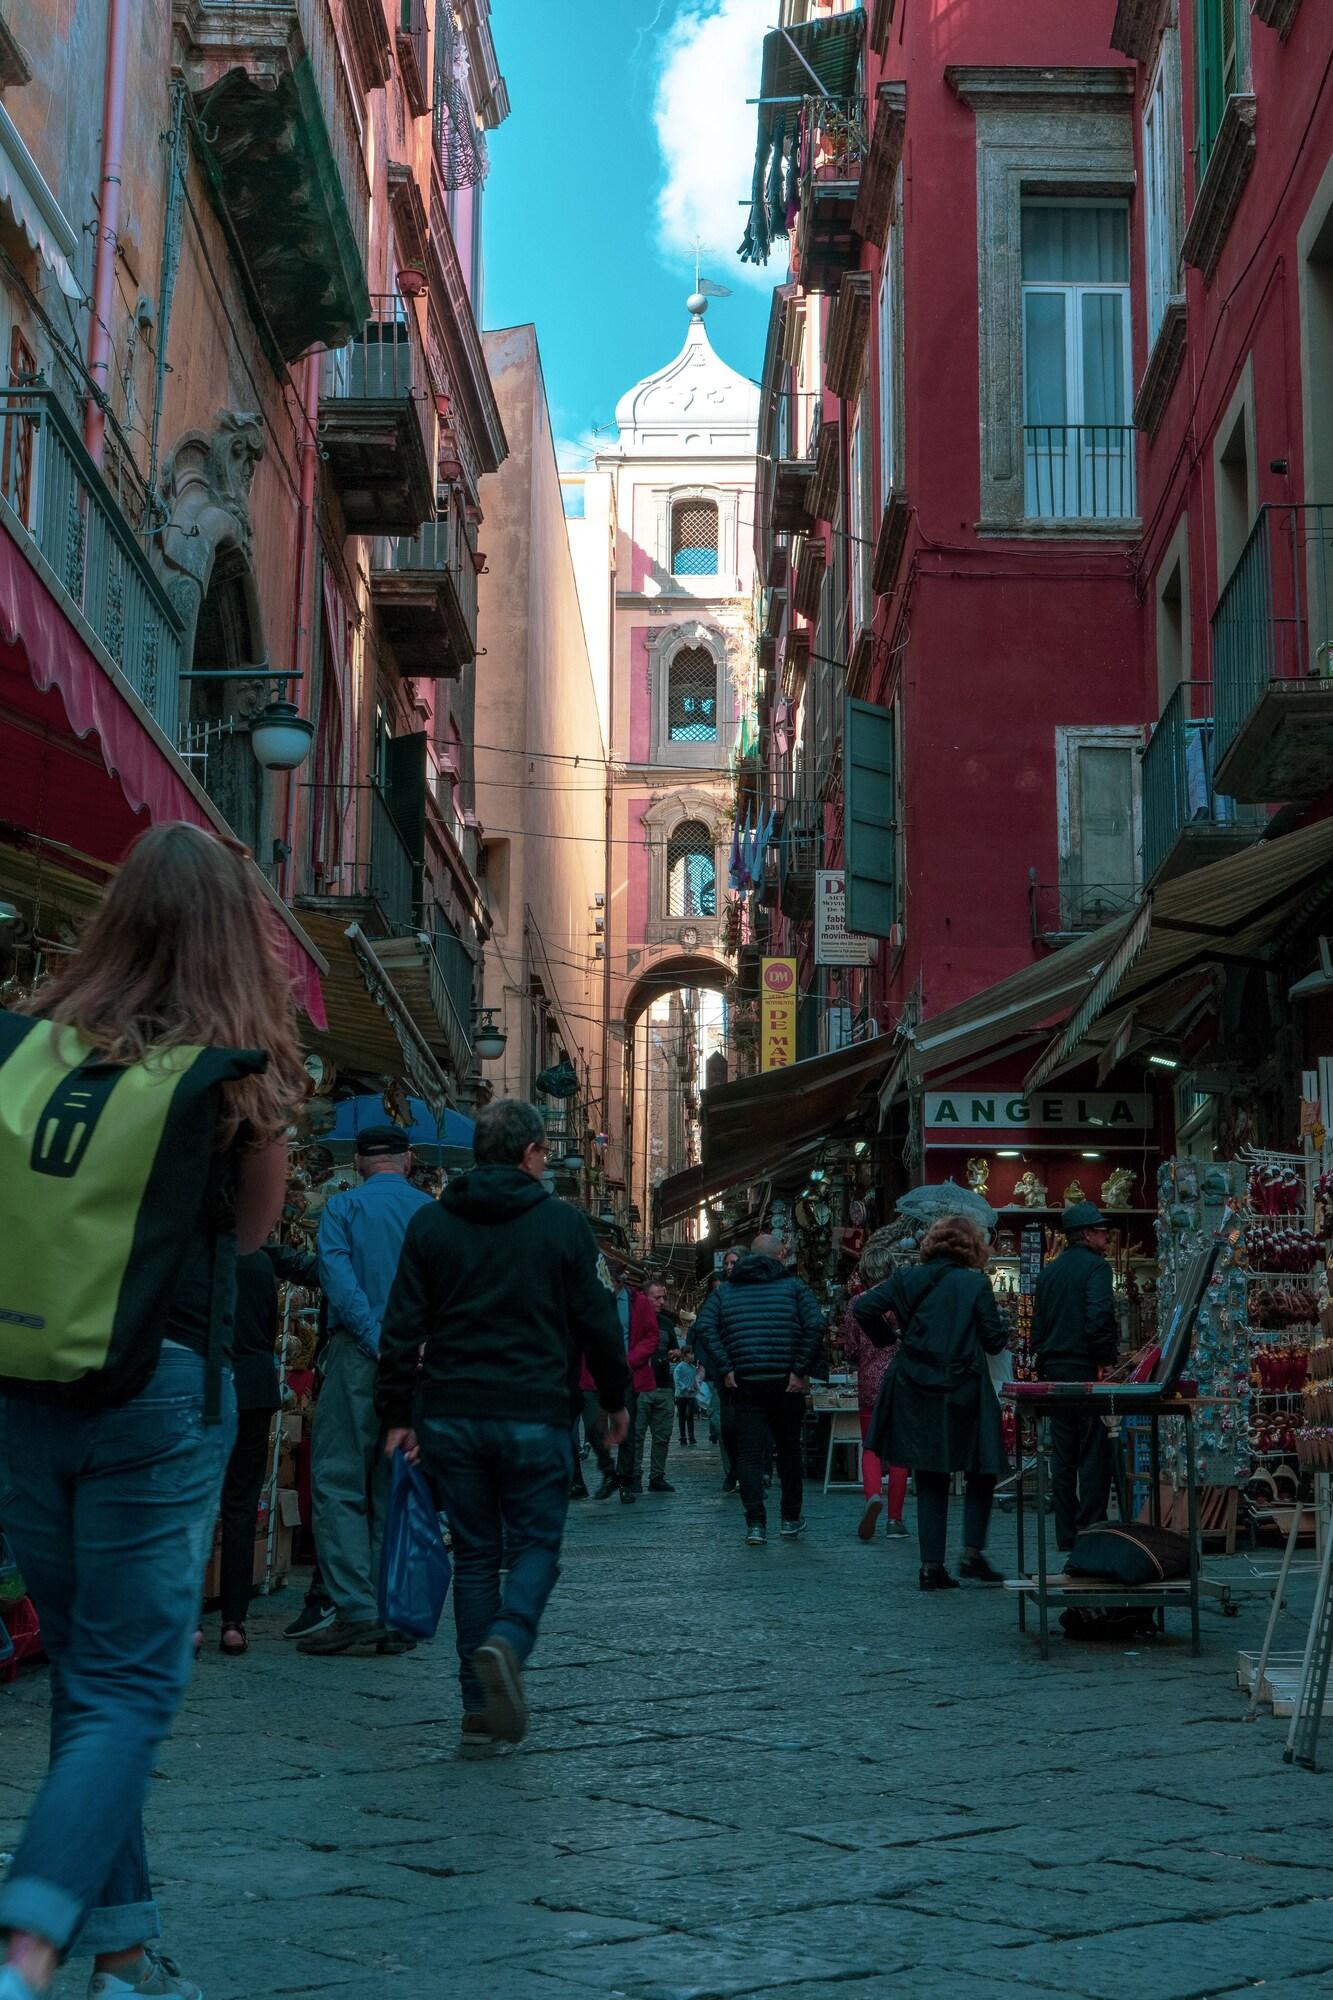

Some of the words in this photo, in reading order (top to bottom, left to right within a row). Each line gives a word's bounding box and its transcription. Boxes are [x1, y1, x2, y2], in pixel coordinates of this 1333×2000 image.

[825, 924, 845, 932] past
[770, 1010, 788, 1030] DE
[934, 1099, 1135, 1123] ANGELA
